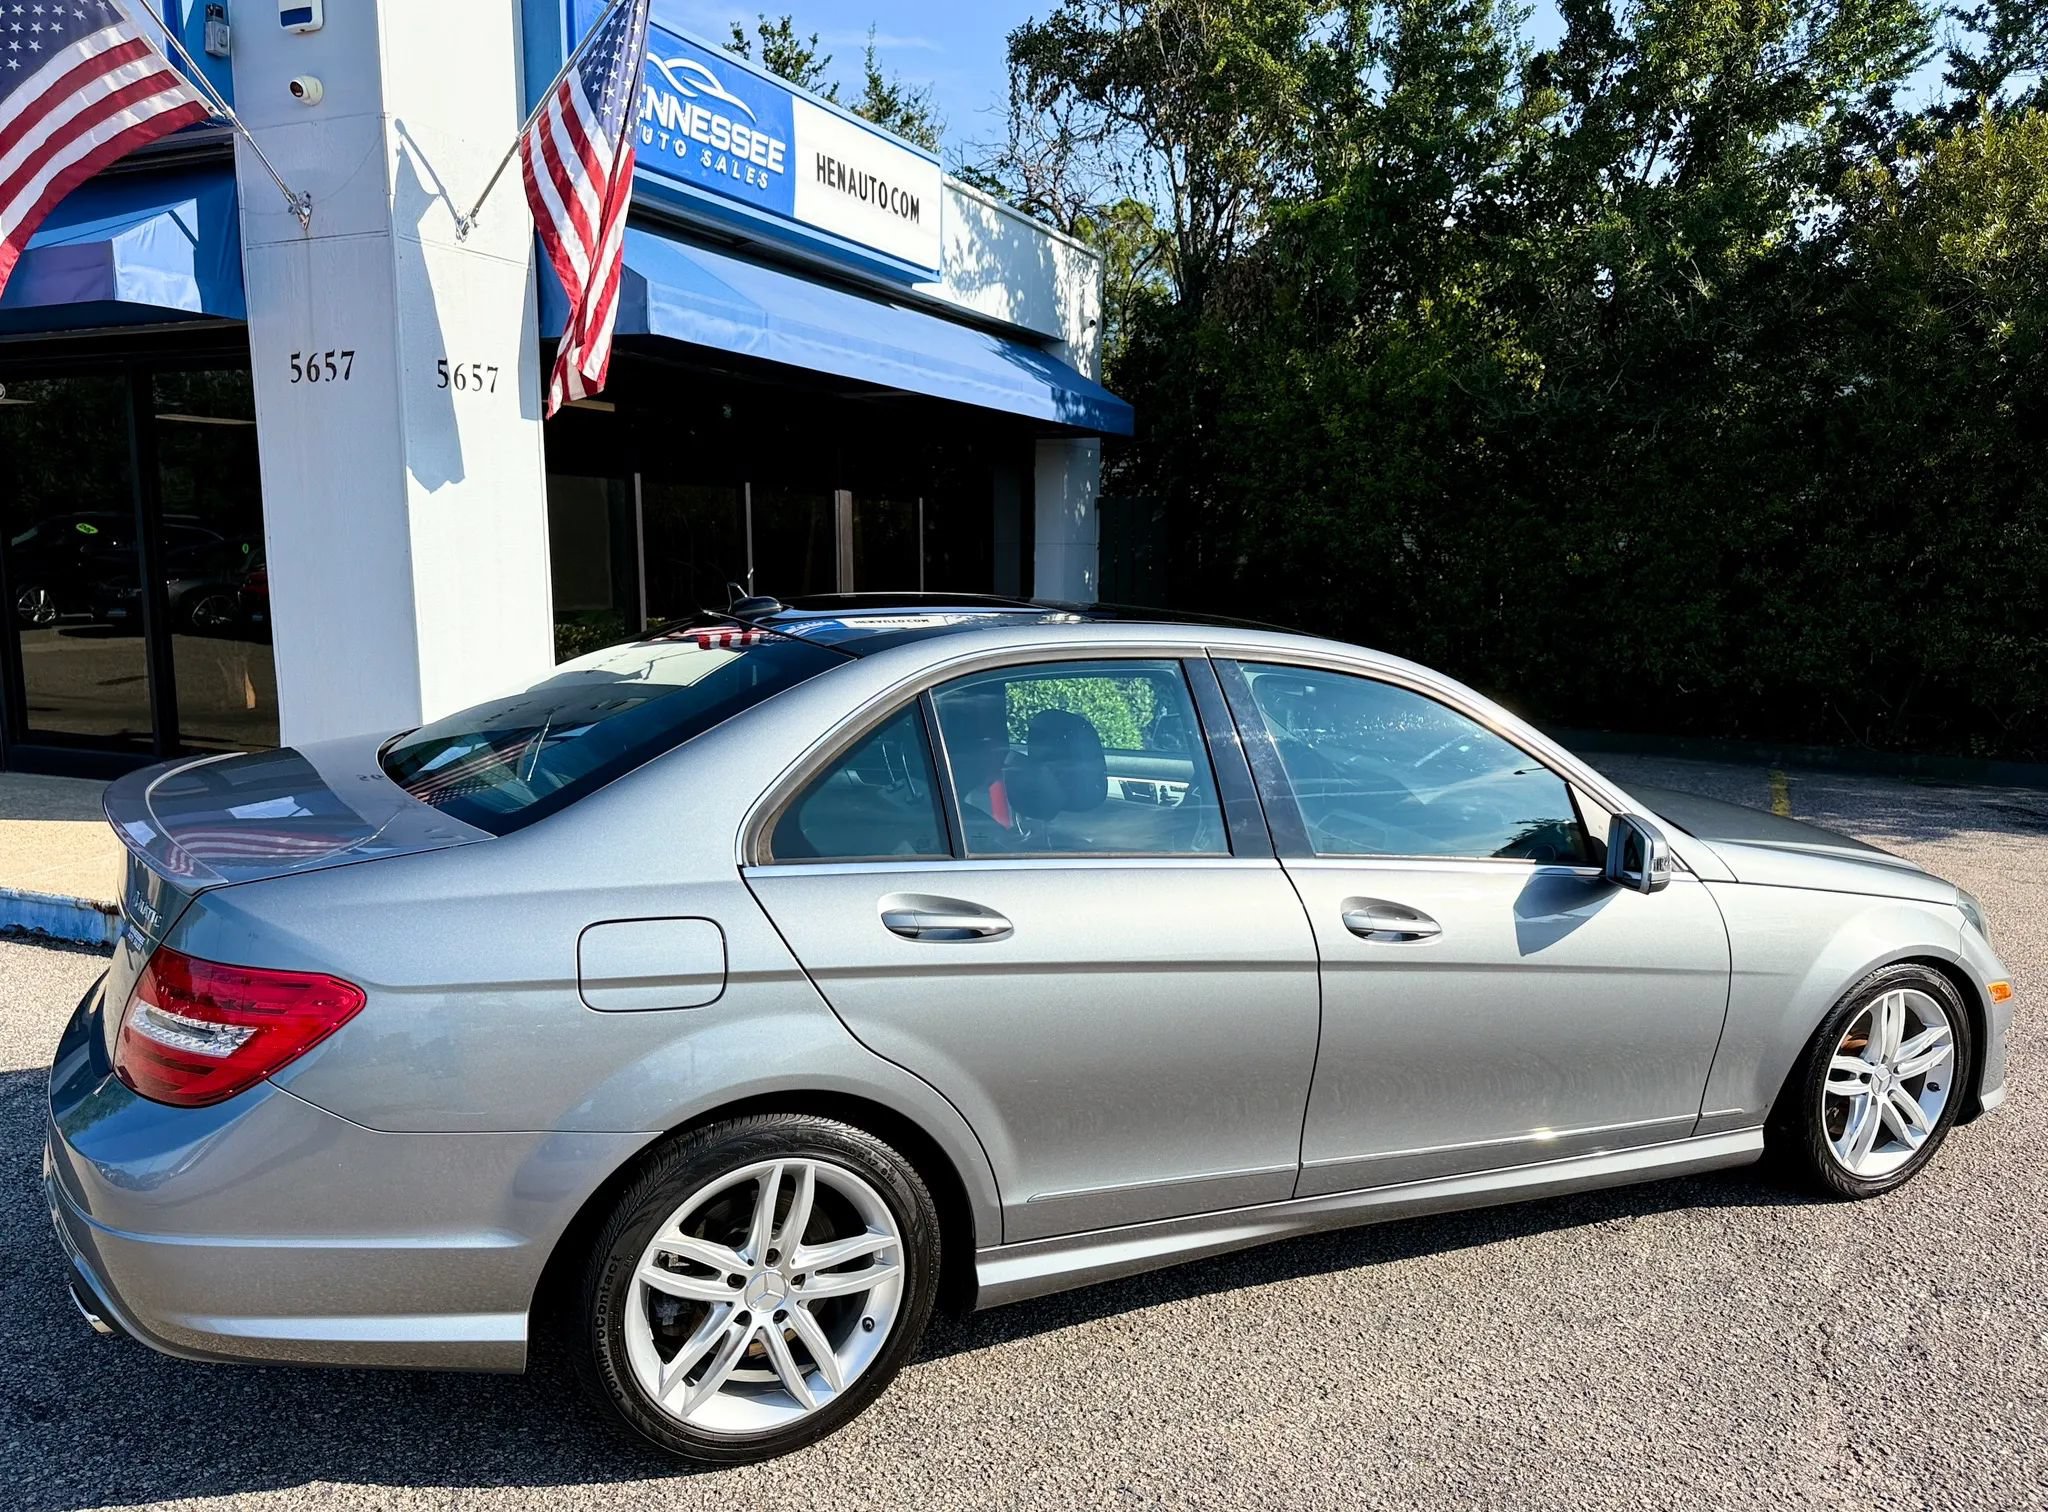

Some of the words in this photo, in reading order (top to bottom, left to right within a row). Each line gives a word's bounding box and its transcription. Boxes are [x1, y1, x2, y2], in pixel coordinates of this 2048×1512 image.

[640, 124, 687, 158] UTO
[701, 148, 769, 190] SALES
[289, 350, 356, 384] 5657
[436, 358, 499, 394] 5657
